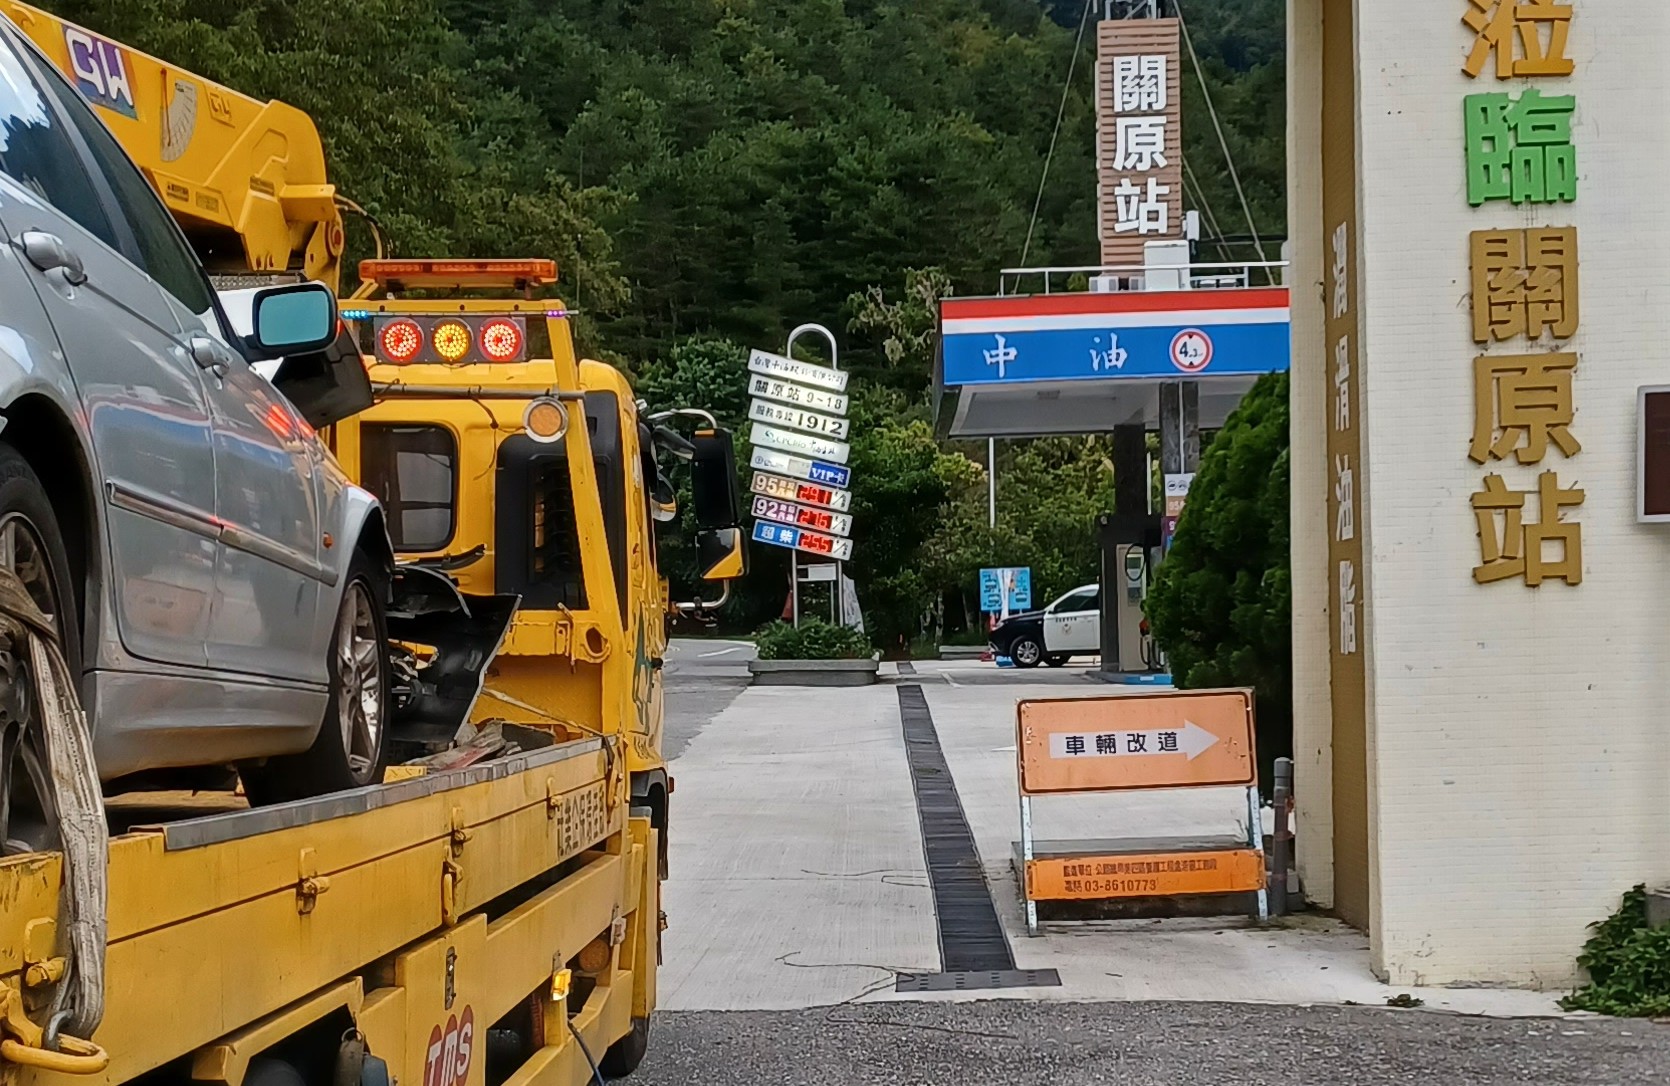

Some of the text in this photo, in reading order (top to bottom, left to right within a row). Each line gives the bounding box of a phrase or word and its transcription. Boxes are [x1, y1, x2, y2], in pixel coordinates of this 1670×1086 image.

[1112, 54, 1170, 235] 關原站
[983, 332, 1129, 379] 中油
[754, 378, 801, 403] 關原站
[797, 412, 843, 437] 1912
[755, 474, 778, 495] 95
[755, 500, 778, 520] 92
[1065, 731, 1179, 756] 車輛改道
